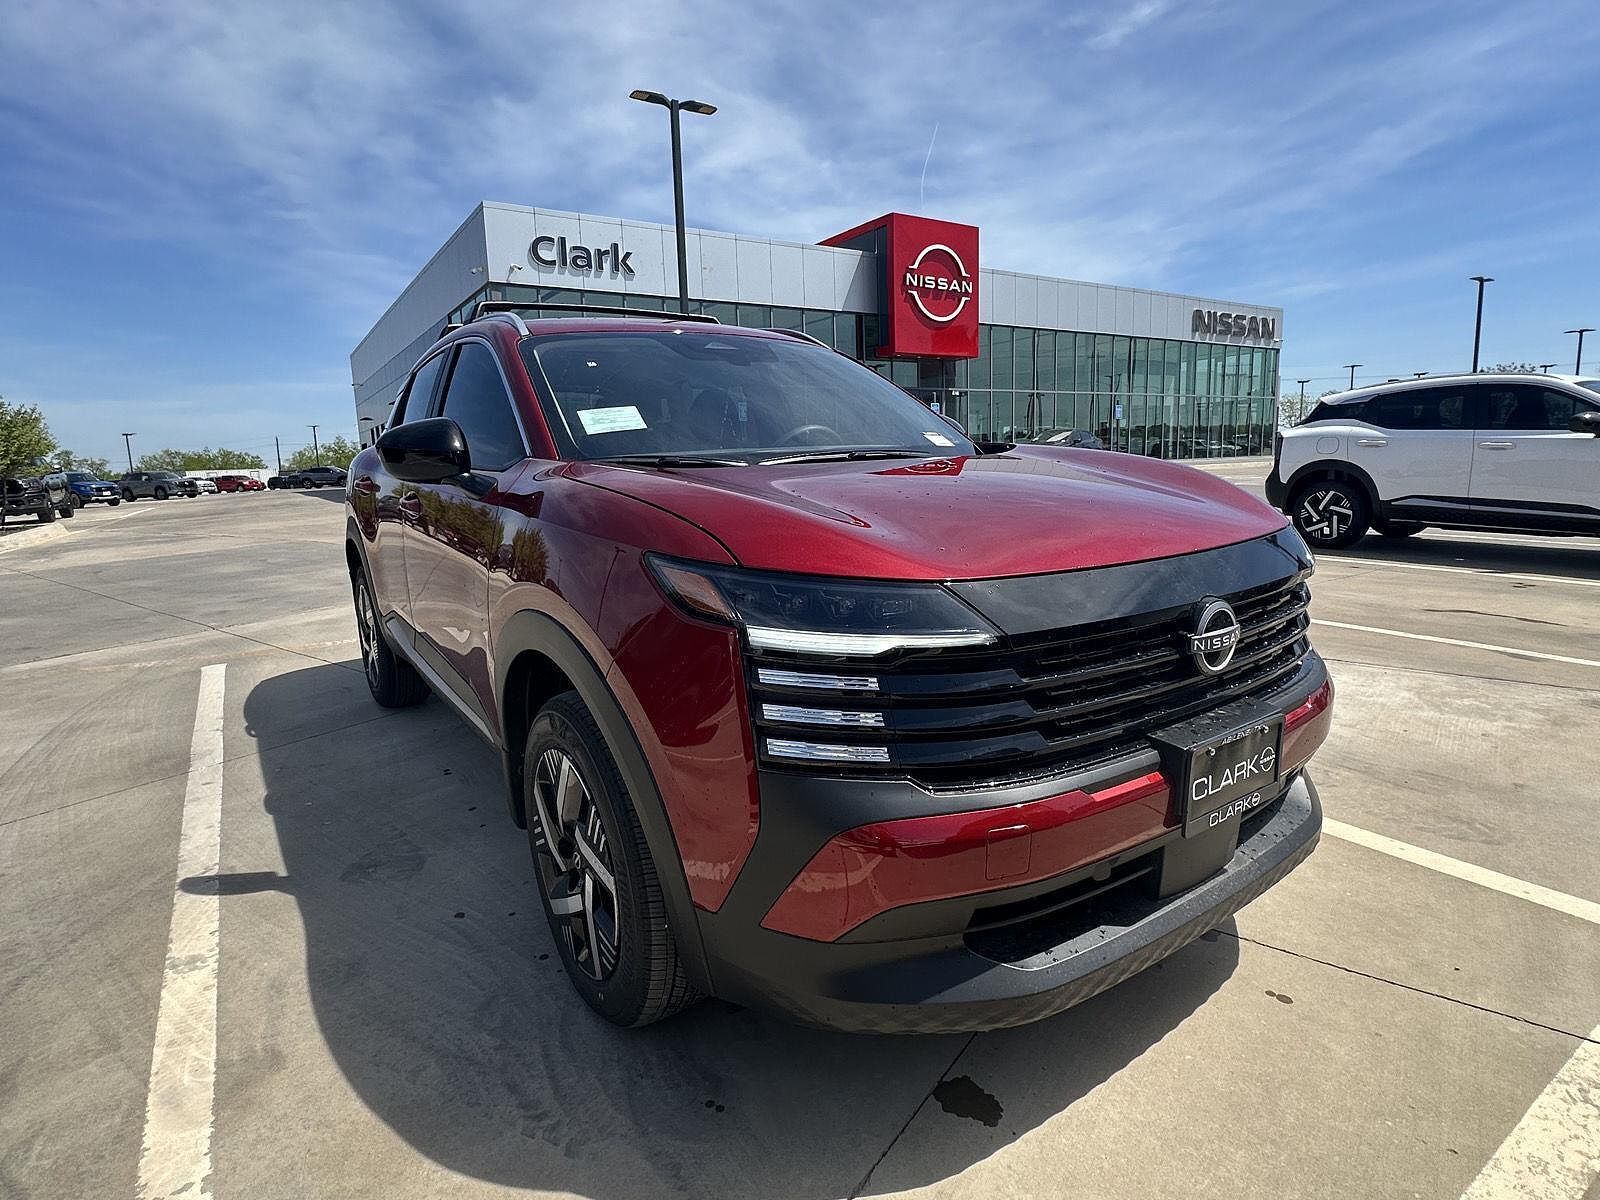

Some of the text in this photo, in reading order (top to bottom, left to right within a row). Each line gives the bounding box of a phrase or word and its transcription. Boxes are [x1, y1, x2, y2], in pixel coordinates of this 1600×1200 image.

[530, 235, 636, 276] Clark
[906, 272, 973, 293] NISSAN
[1191, 309, 1276, 340] NISSAN
[1192, 754, 1258, 801] CLARK
[1209, 795, 1252, 827] CLARK
